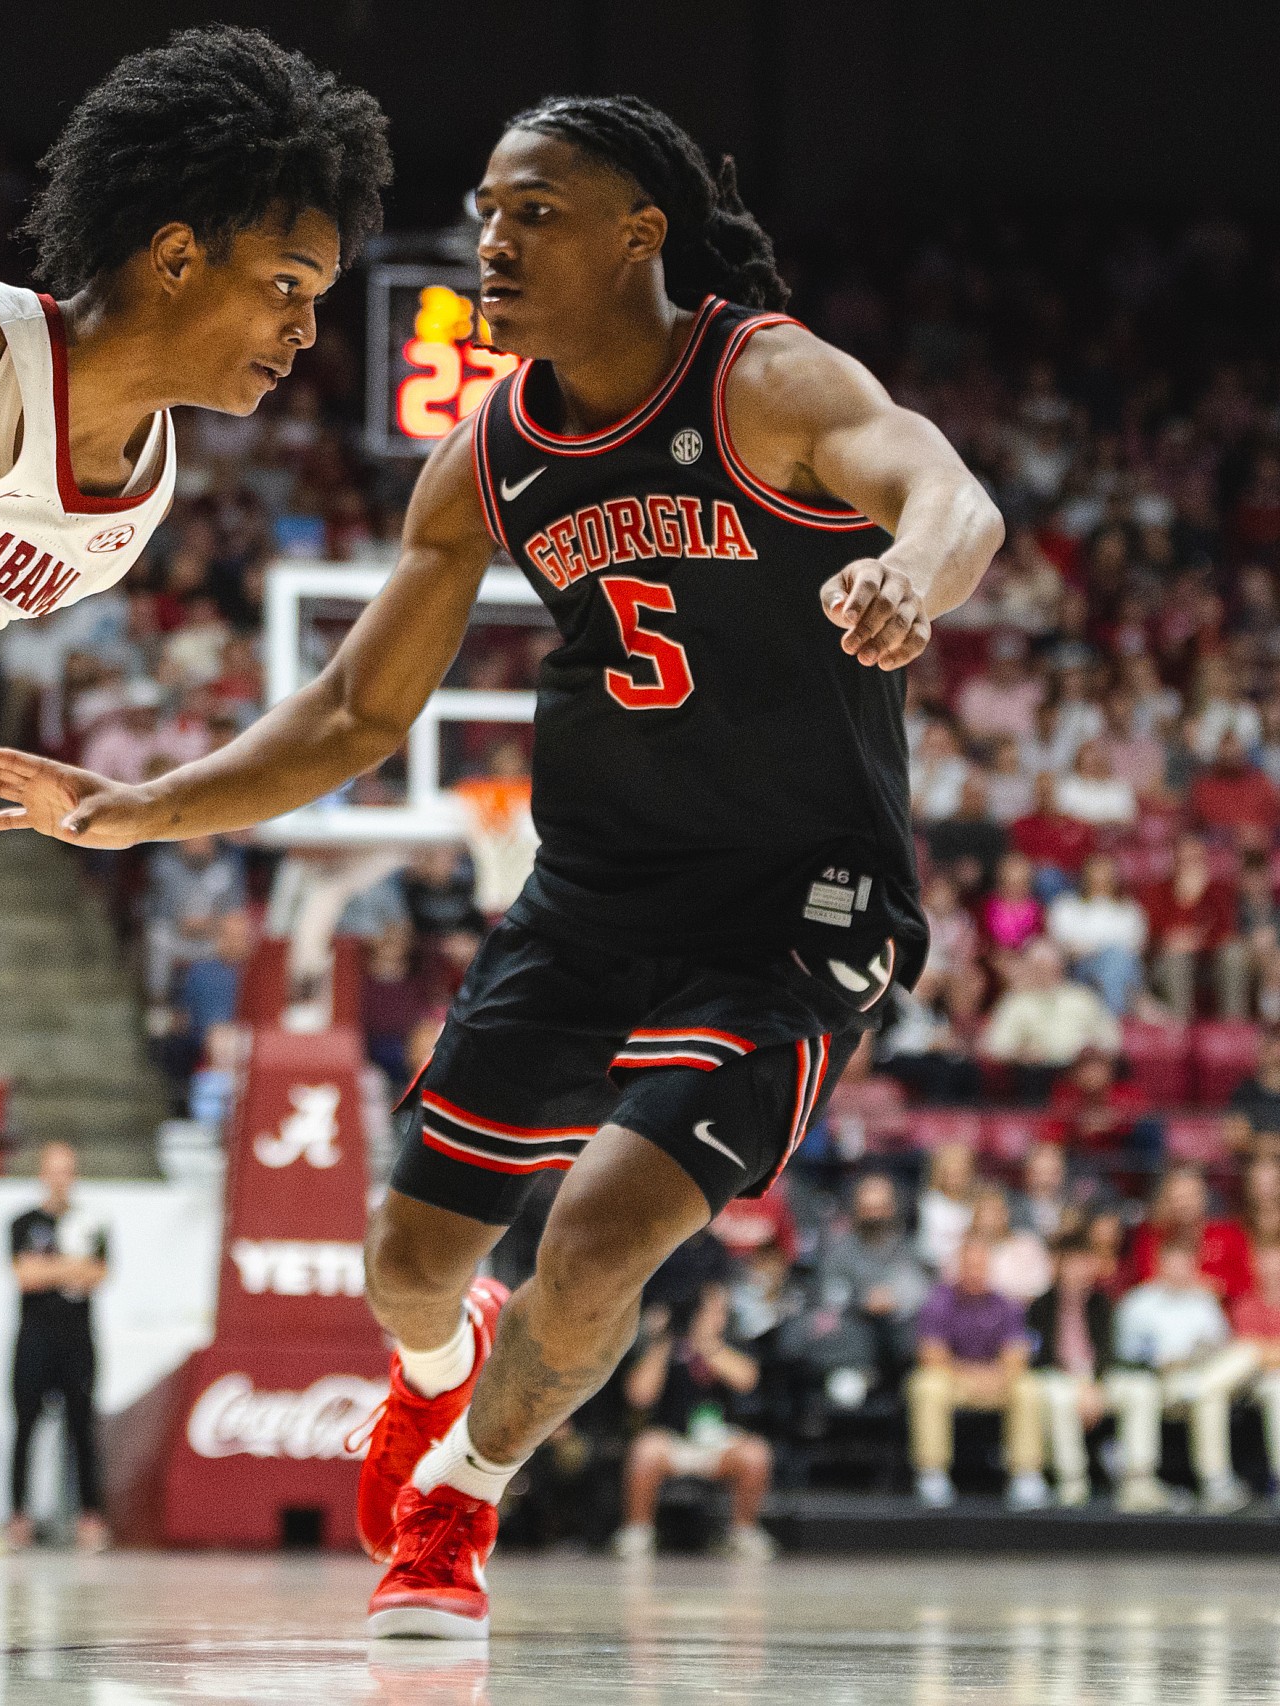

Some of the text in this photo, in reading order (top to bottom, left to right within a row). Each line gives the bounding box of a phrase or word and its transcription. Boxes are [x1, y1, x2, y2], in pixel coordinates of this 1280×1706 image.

[675, 432, 700, 461] SEC
[524, 495, 758, 591] GEORGIA
[600, 575, 695, 710] 5
[822, 867, 850, 884] 46
